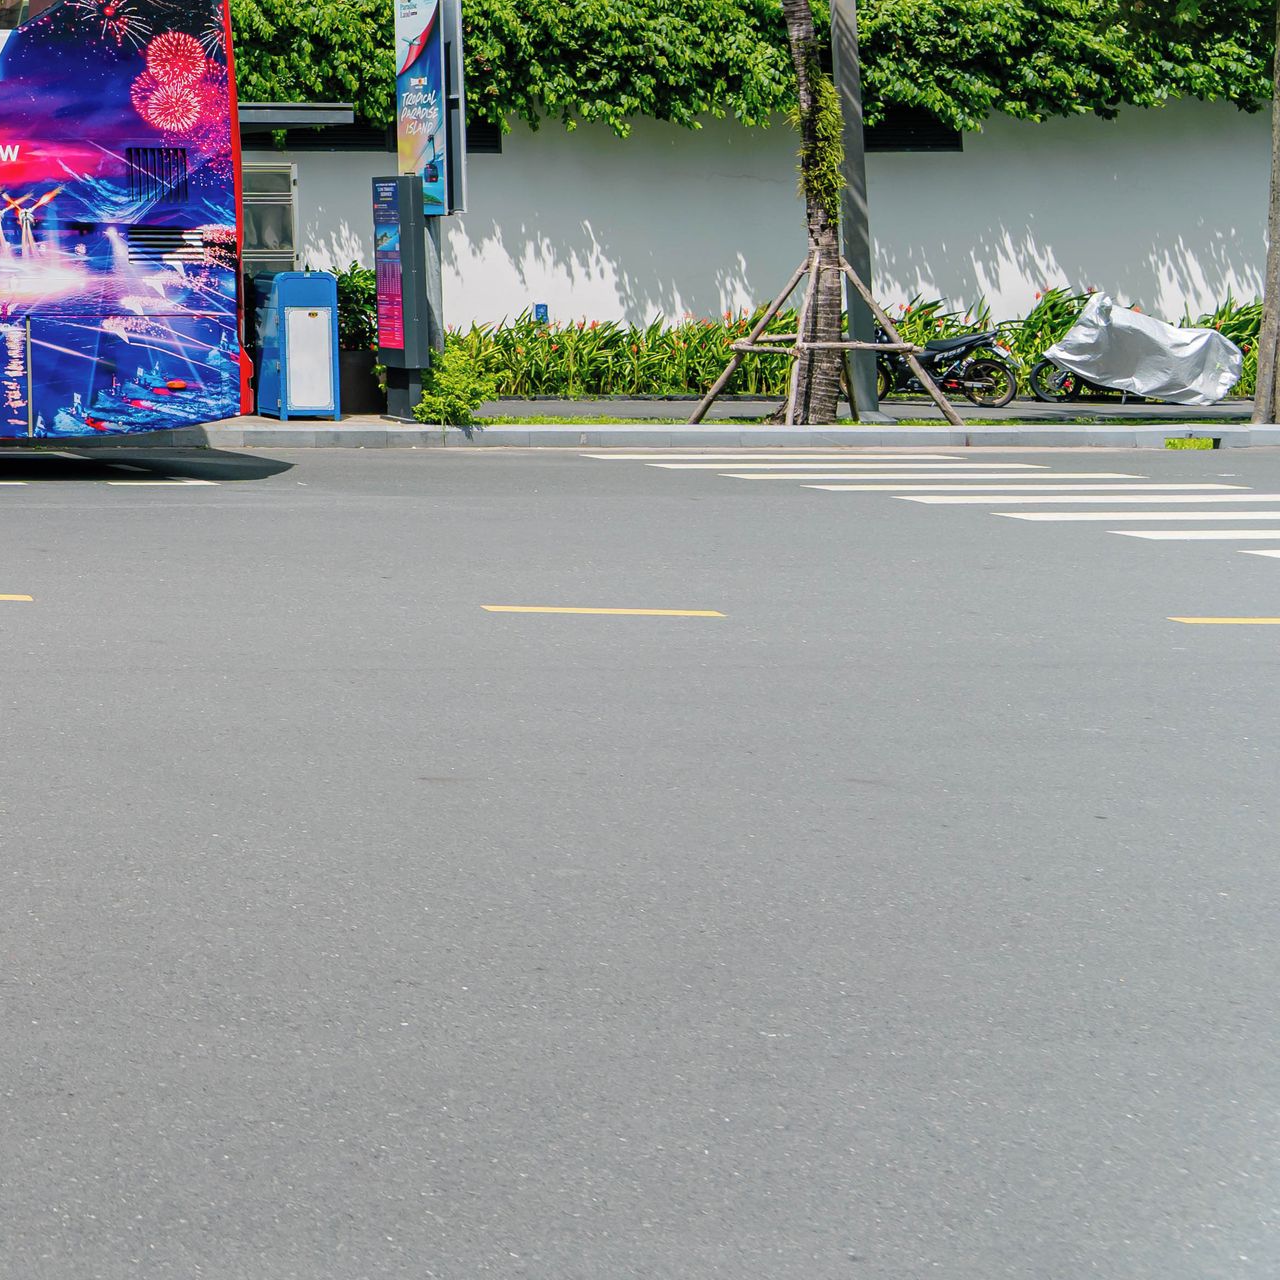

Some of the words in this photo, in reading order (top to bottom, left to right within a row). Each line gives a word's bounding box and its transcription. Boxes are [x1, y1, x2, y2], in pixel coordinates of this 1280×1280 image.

[402, 90, 437, 107] TROPICAL
[401, 106, 439, 122] PARADISE
[406, 121, 433, 135] ISLAND
